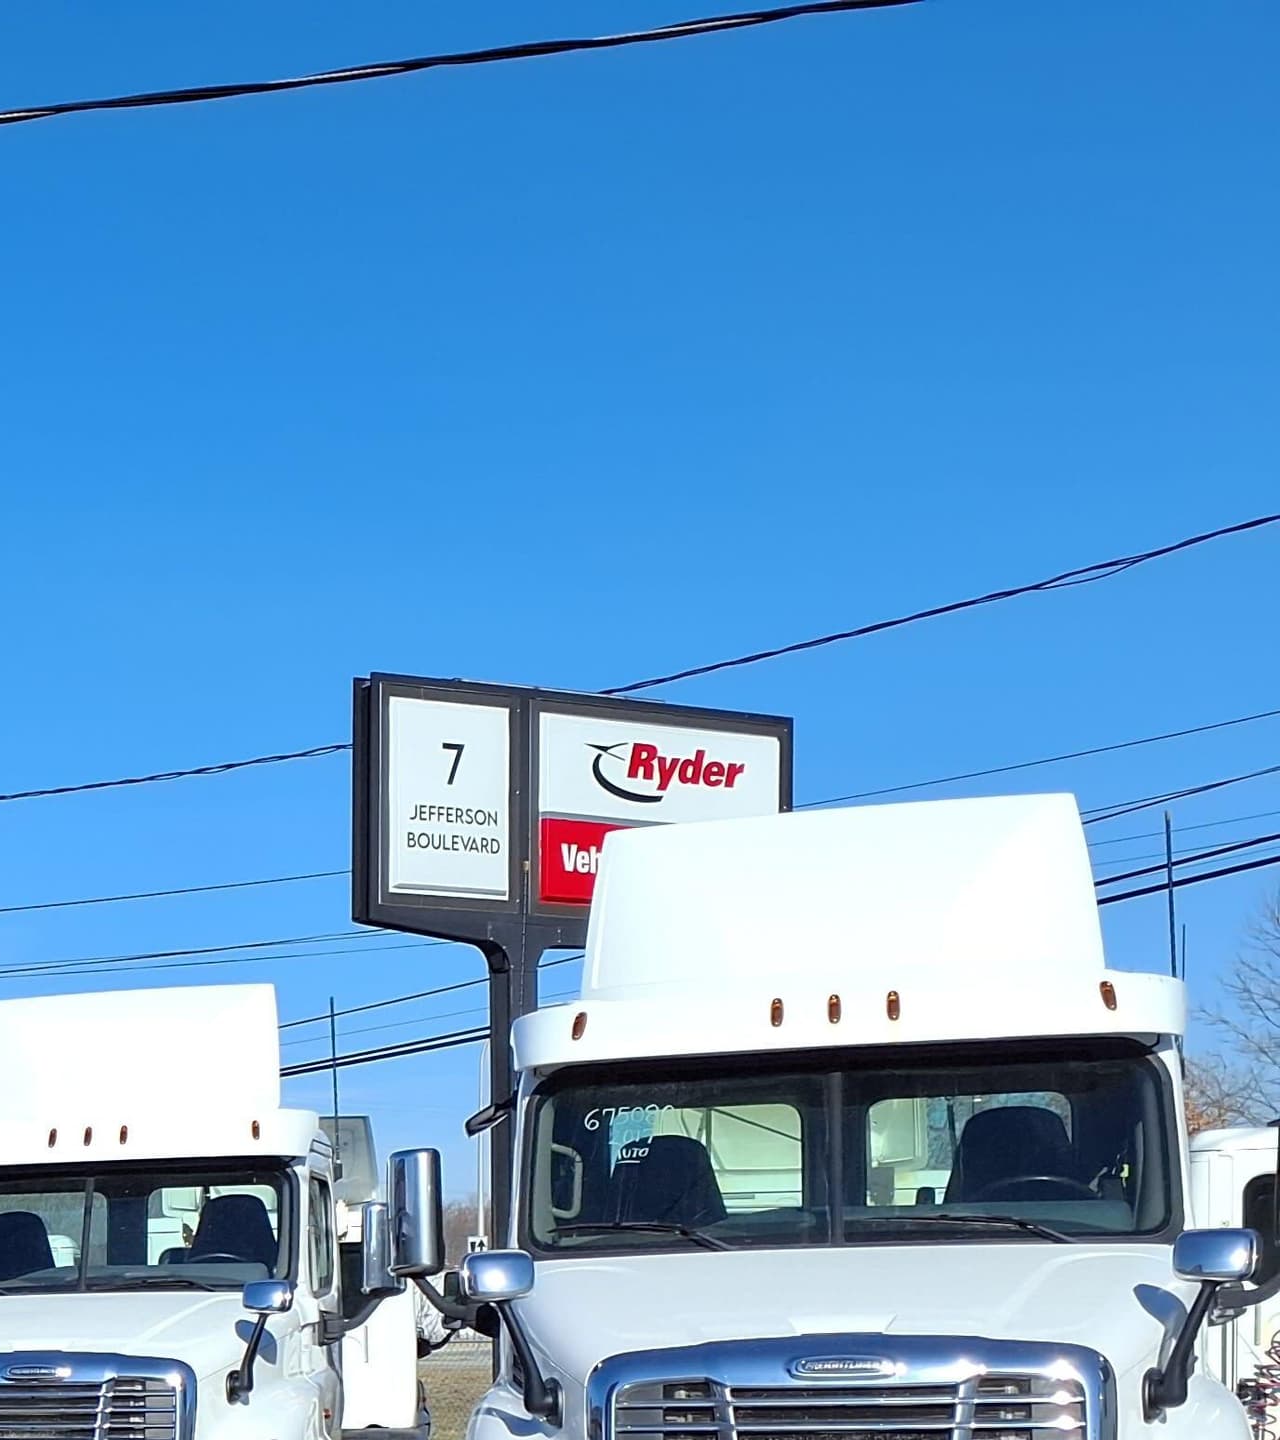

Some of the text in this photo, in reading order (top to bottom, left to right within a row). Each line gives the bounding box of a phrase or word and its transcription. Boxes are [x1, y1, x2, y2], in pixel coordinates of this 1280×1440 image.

[442, 742, 465, 785] 7
[627, 742, 745, 791] Ryder
[409, 804, 498, 826] JEFFERSON
[407, 831, 500, 855] BOULEVARD
